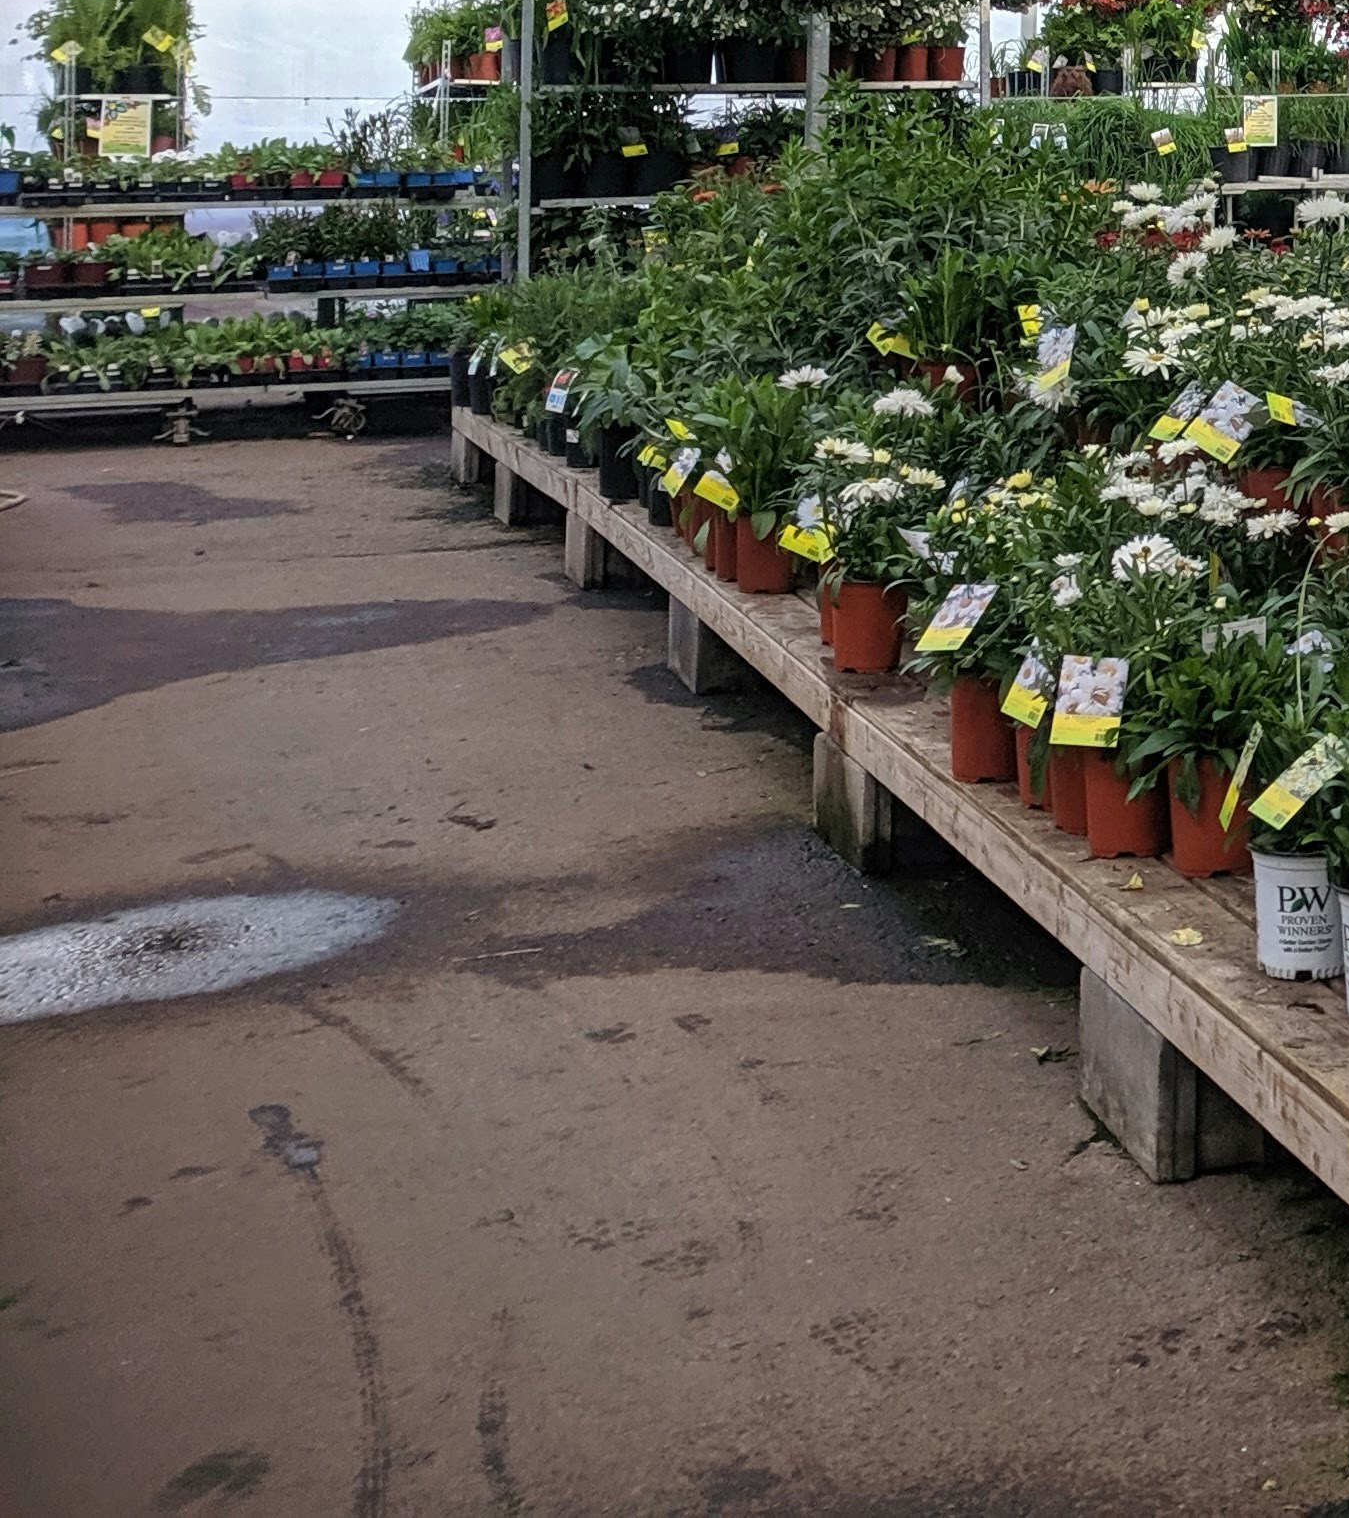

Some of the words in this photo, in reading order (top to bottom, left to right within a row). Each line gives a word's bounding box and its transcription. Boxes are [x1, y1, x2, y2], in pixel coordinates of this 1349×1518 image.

[1276, 885, 1332, 913] PW
[1281, 914, 1328, 925] PROVEN
[1276, 925, 1333, 936] WINNERS
